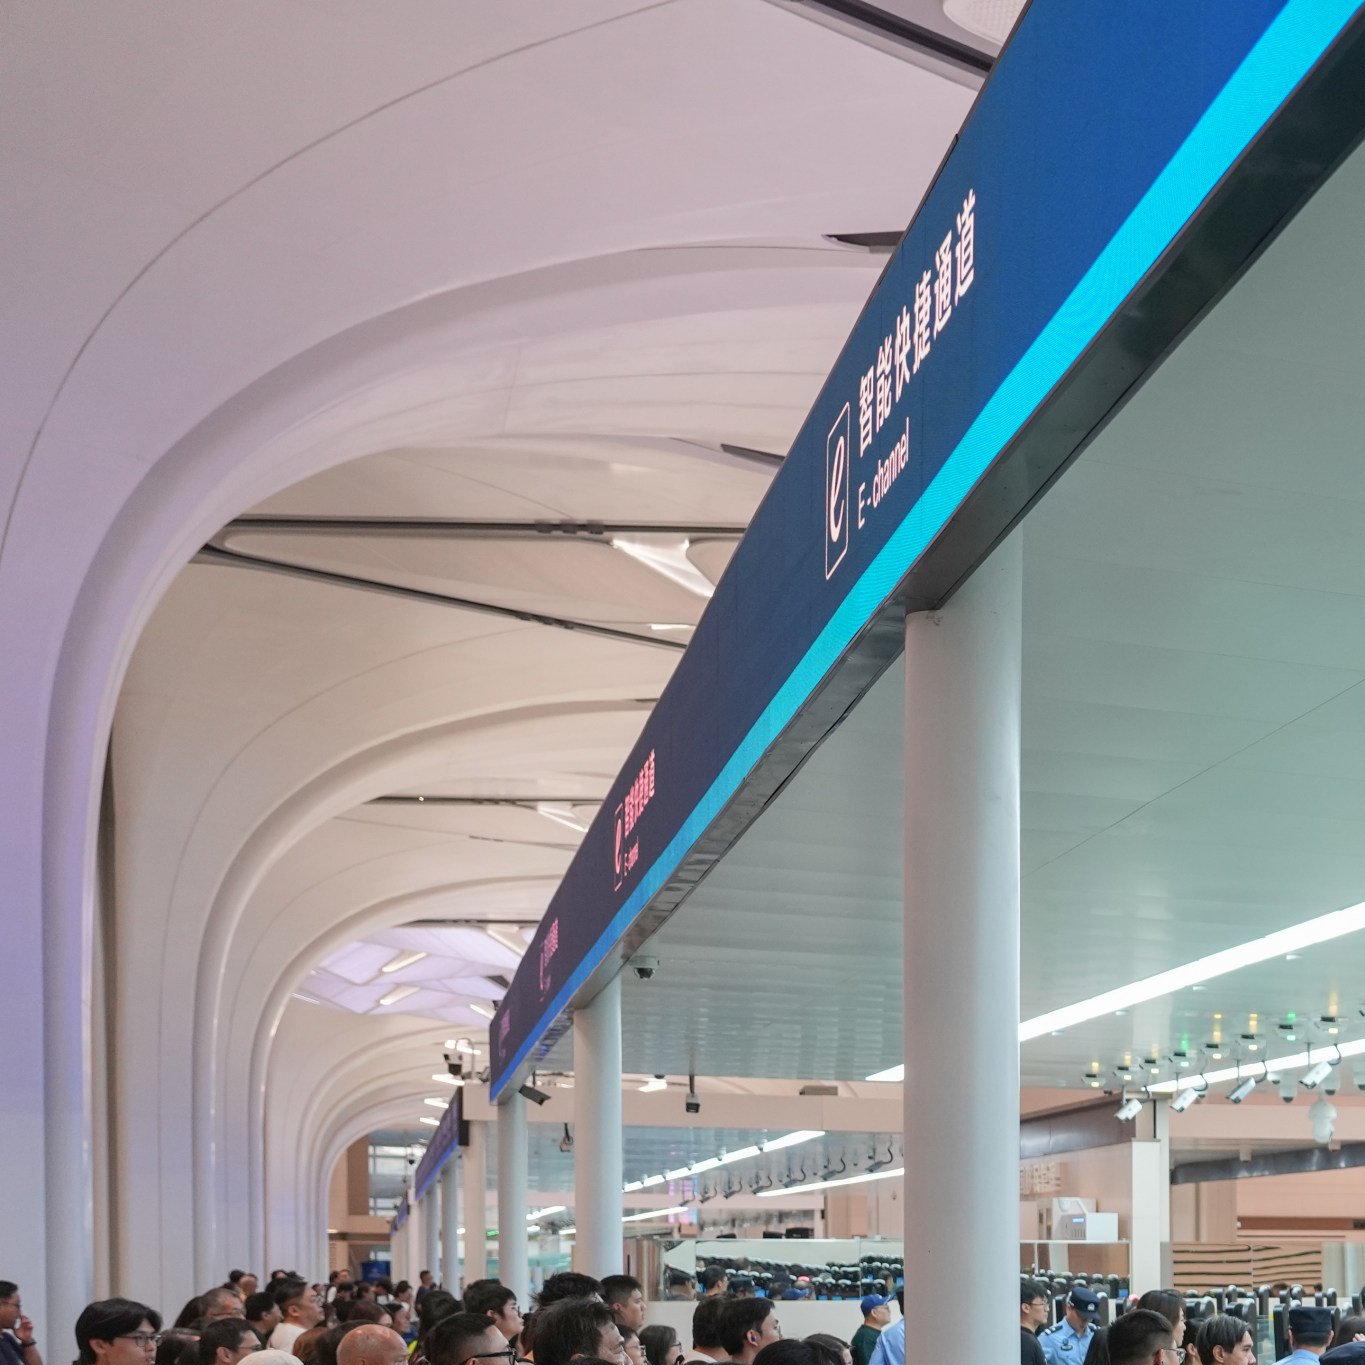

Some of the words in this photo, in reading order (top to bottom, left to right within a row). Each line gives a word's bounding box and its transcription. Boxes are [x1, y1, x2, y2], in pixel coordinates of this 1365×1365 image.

[859, 188, 976, 458] 智能快捷通道
